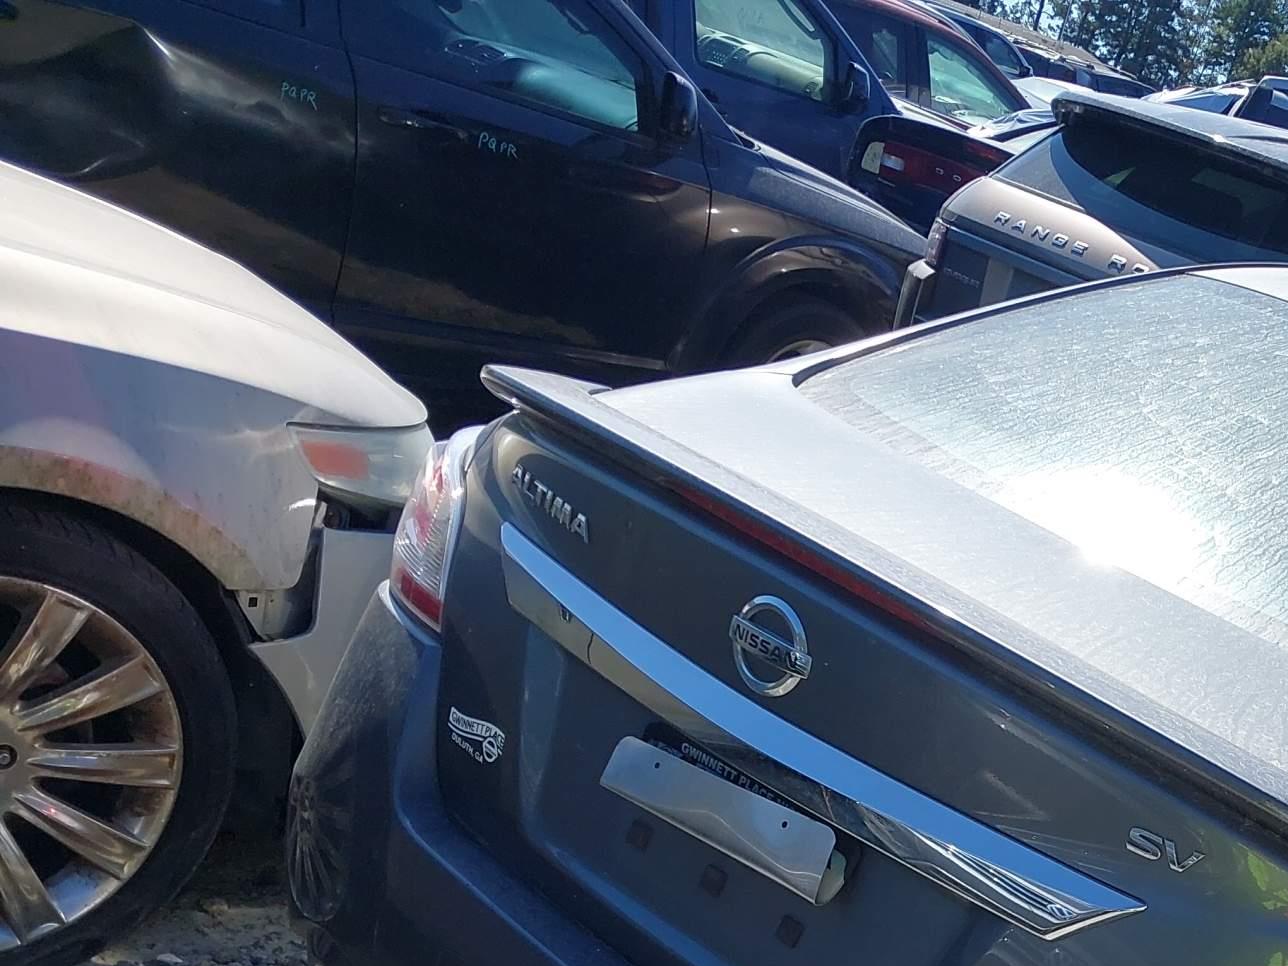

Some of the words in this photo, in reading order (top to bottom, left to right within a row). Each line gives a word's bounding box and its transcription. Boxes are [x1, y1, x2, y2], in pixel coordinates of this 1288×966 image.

[993, 210, 1089, 256] RANGE
[512, 463, 589, 544] ALTIMA
[681, 742, 737, 780] GWINNETT
[1125, 826, 1206, 873] SV
